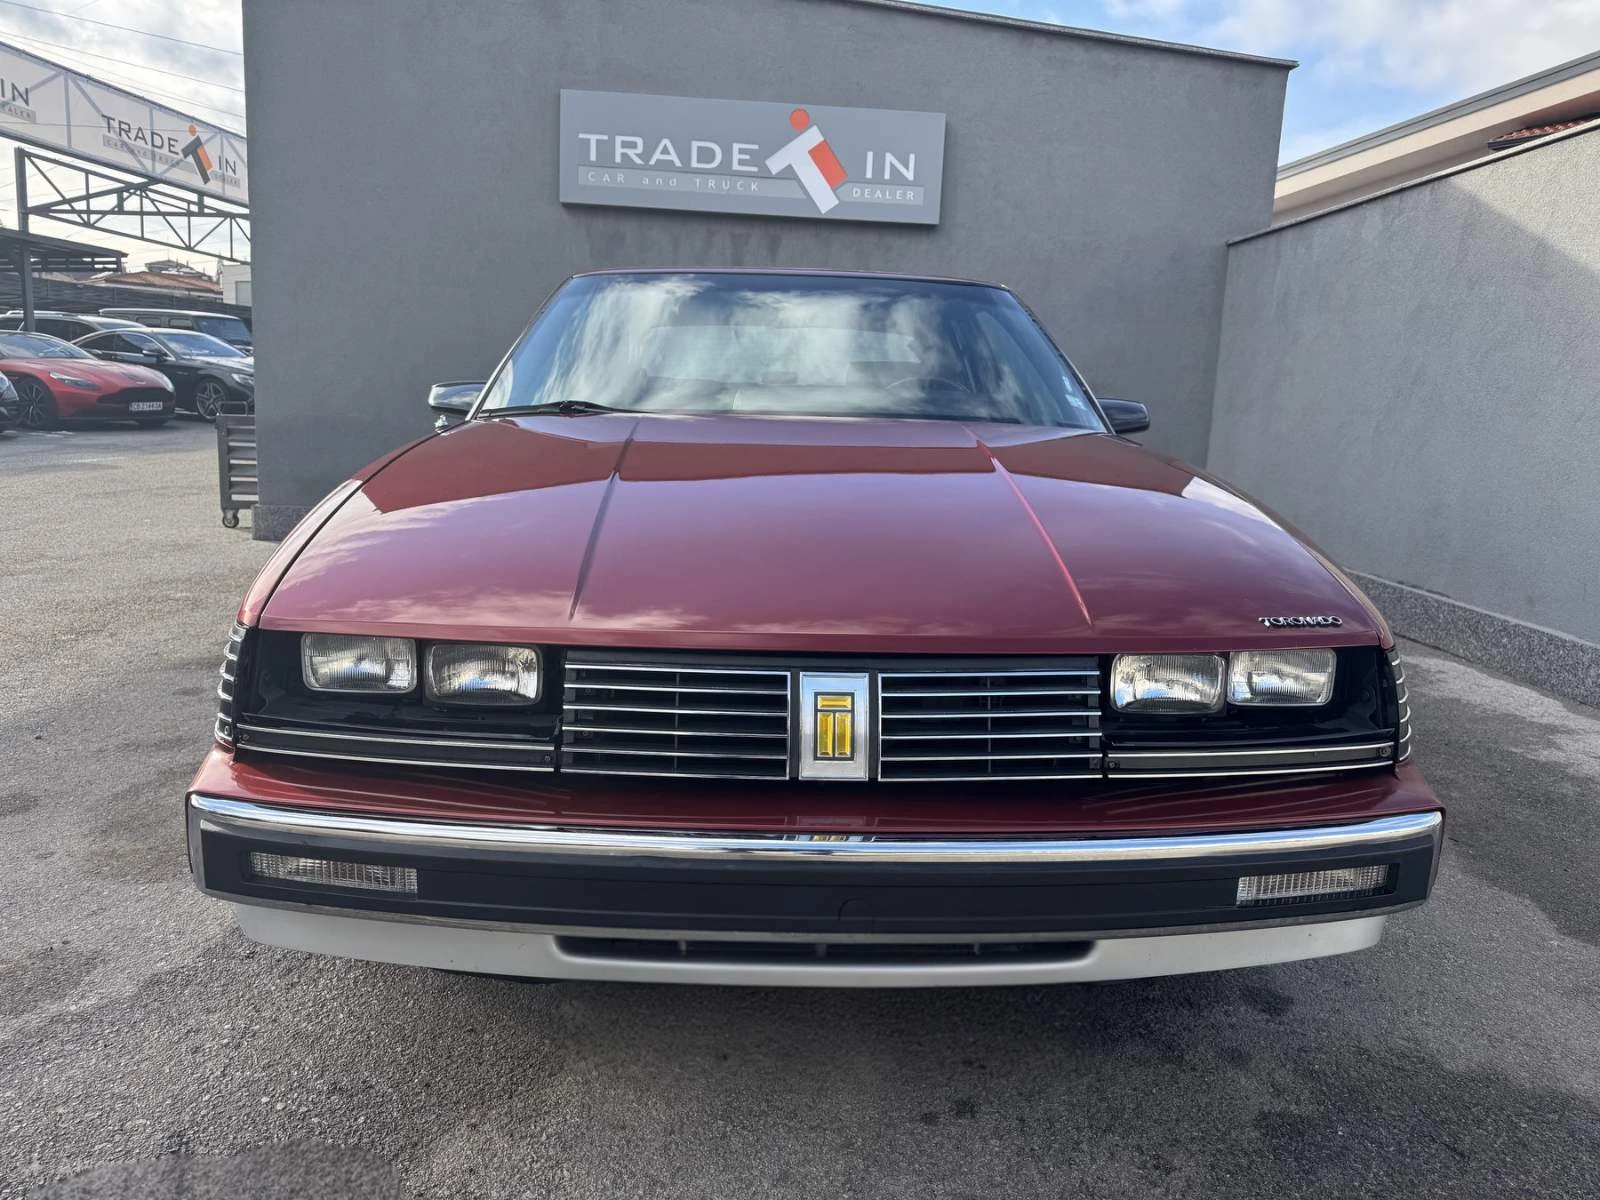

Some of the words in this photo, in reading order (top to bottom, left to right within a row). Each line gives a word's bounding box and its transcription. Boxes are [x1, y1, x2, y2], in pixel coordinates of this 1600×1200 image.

[1, 78, 29, 107] IN
[101, 114, 179, 155] TRADE
[218, 155, 236, 176] IN
[578, 133, 759, 173] TRADE
[865, 151, 915, 181] IN
[588, 172, 626, 185] CAR
[642, 175, 677, 187] and
[695, 178, 759, 192] TRUCK
[852, 187, 915, 201] DEALER
